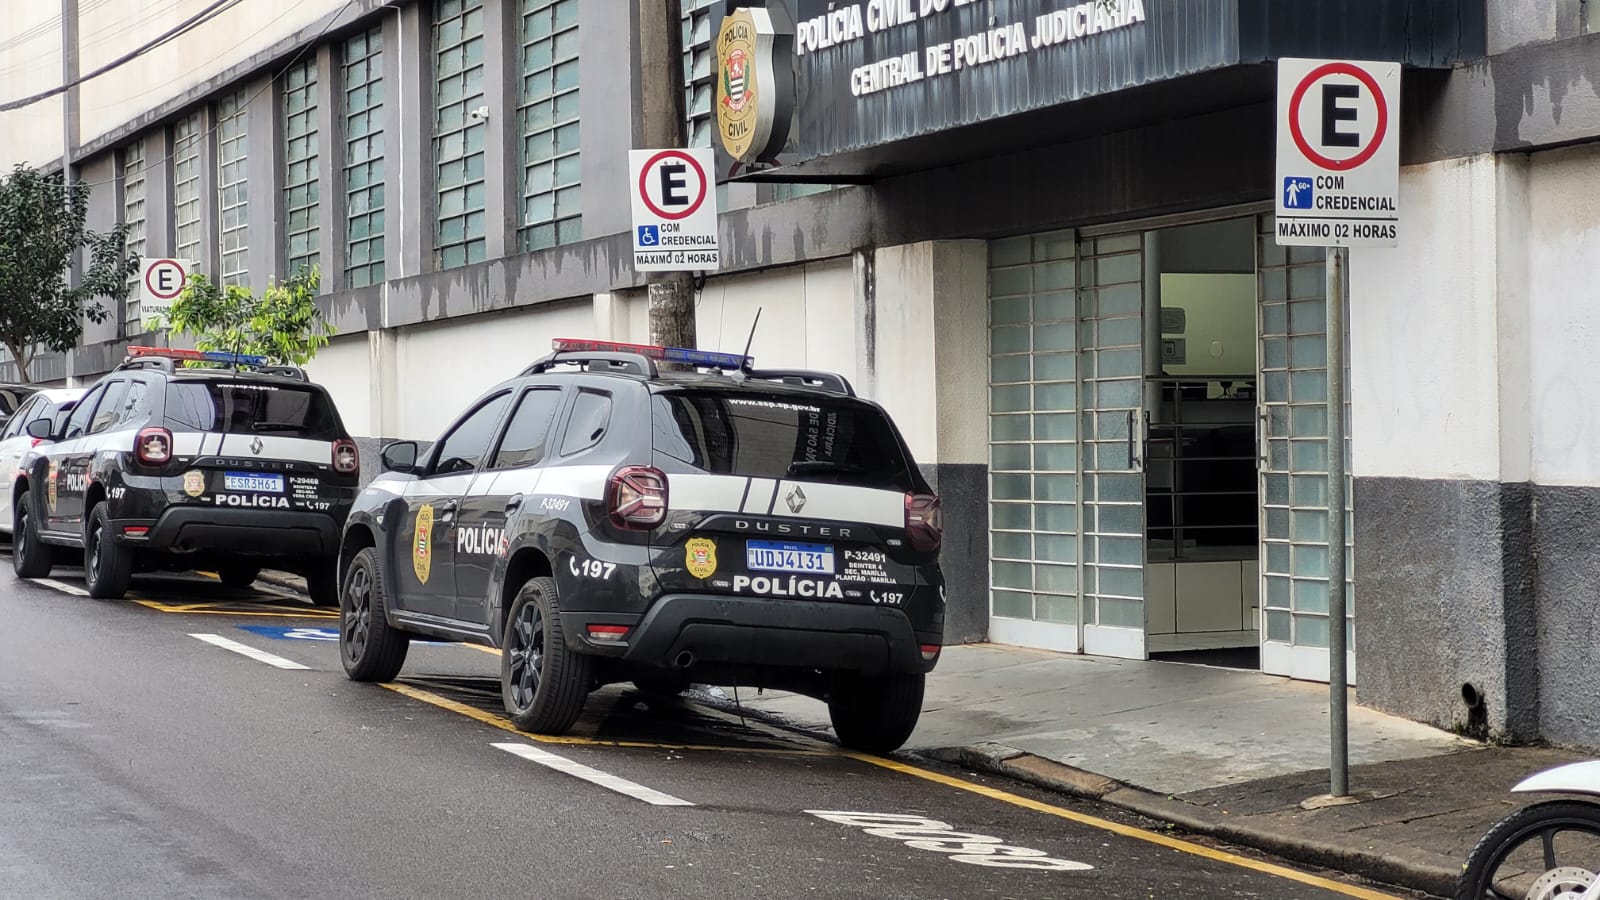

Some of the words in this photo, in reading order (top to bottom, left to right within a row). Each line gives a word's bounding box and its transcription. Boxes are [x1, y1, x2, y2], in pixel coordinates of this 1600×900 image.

[797, 2, 864, 55] POLÍCIA
[867, 0, 917, 33] CIVIL
[851, 51, 924, 97] CENTRAL
[926, 43, 951, 77] DE
[954, 15, 1027, 70] POLÍCIA
[1321, 84, 1360, 147] E
[728, 119, 748, 136] CIVIL
[660, 164, 689, 206] E
[1316, 176, 1344, 190] COM
[1316, 196, 1395, 211] CREDENCIAL
[661, 223, 680, 232] COM
[1334, 223, 1349, 238] 02
[1353, 224, 1396, 239] HORAS
[662, 235, 716, 245] CREDENCIAL
[675, 254, 685, 264] 02
[687, 253, 718, 263] HORAS
[159, 269, 172, 290] E
[216, 459, 293, 469] DUSTER
[230, 477, 277, 490] ESR3H61
[111, 487, 126, 499] 197
[215, 494, 290, 508] POLÍCIA
[314, 502, 330, 510] 197
[735, 520, 851, 537] DUSTER
[844, 550, 886, 563] P-32491
[581, 559, 616, 579] 197
[849, 562, 876, 570] DEINTER
[835, 574, 866, 582] PLANTÃO
[733, 575, 844, 598] POLÍCIA
[881, 592, 904, 604] 197
